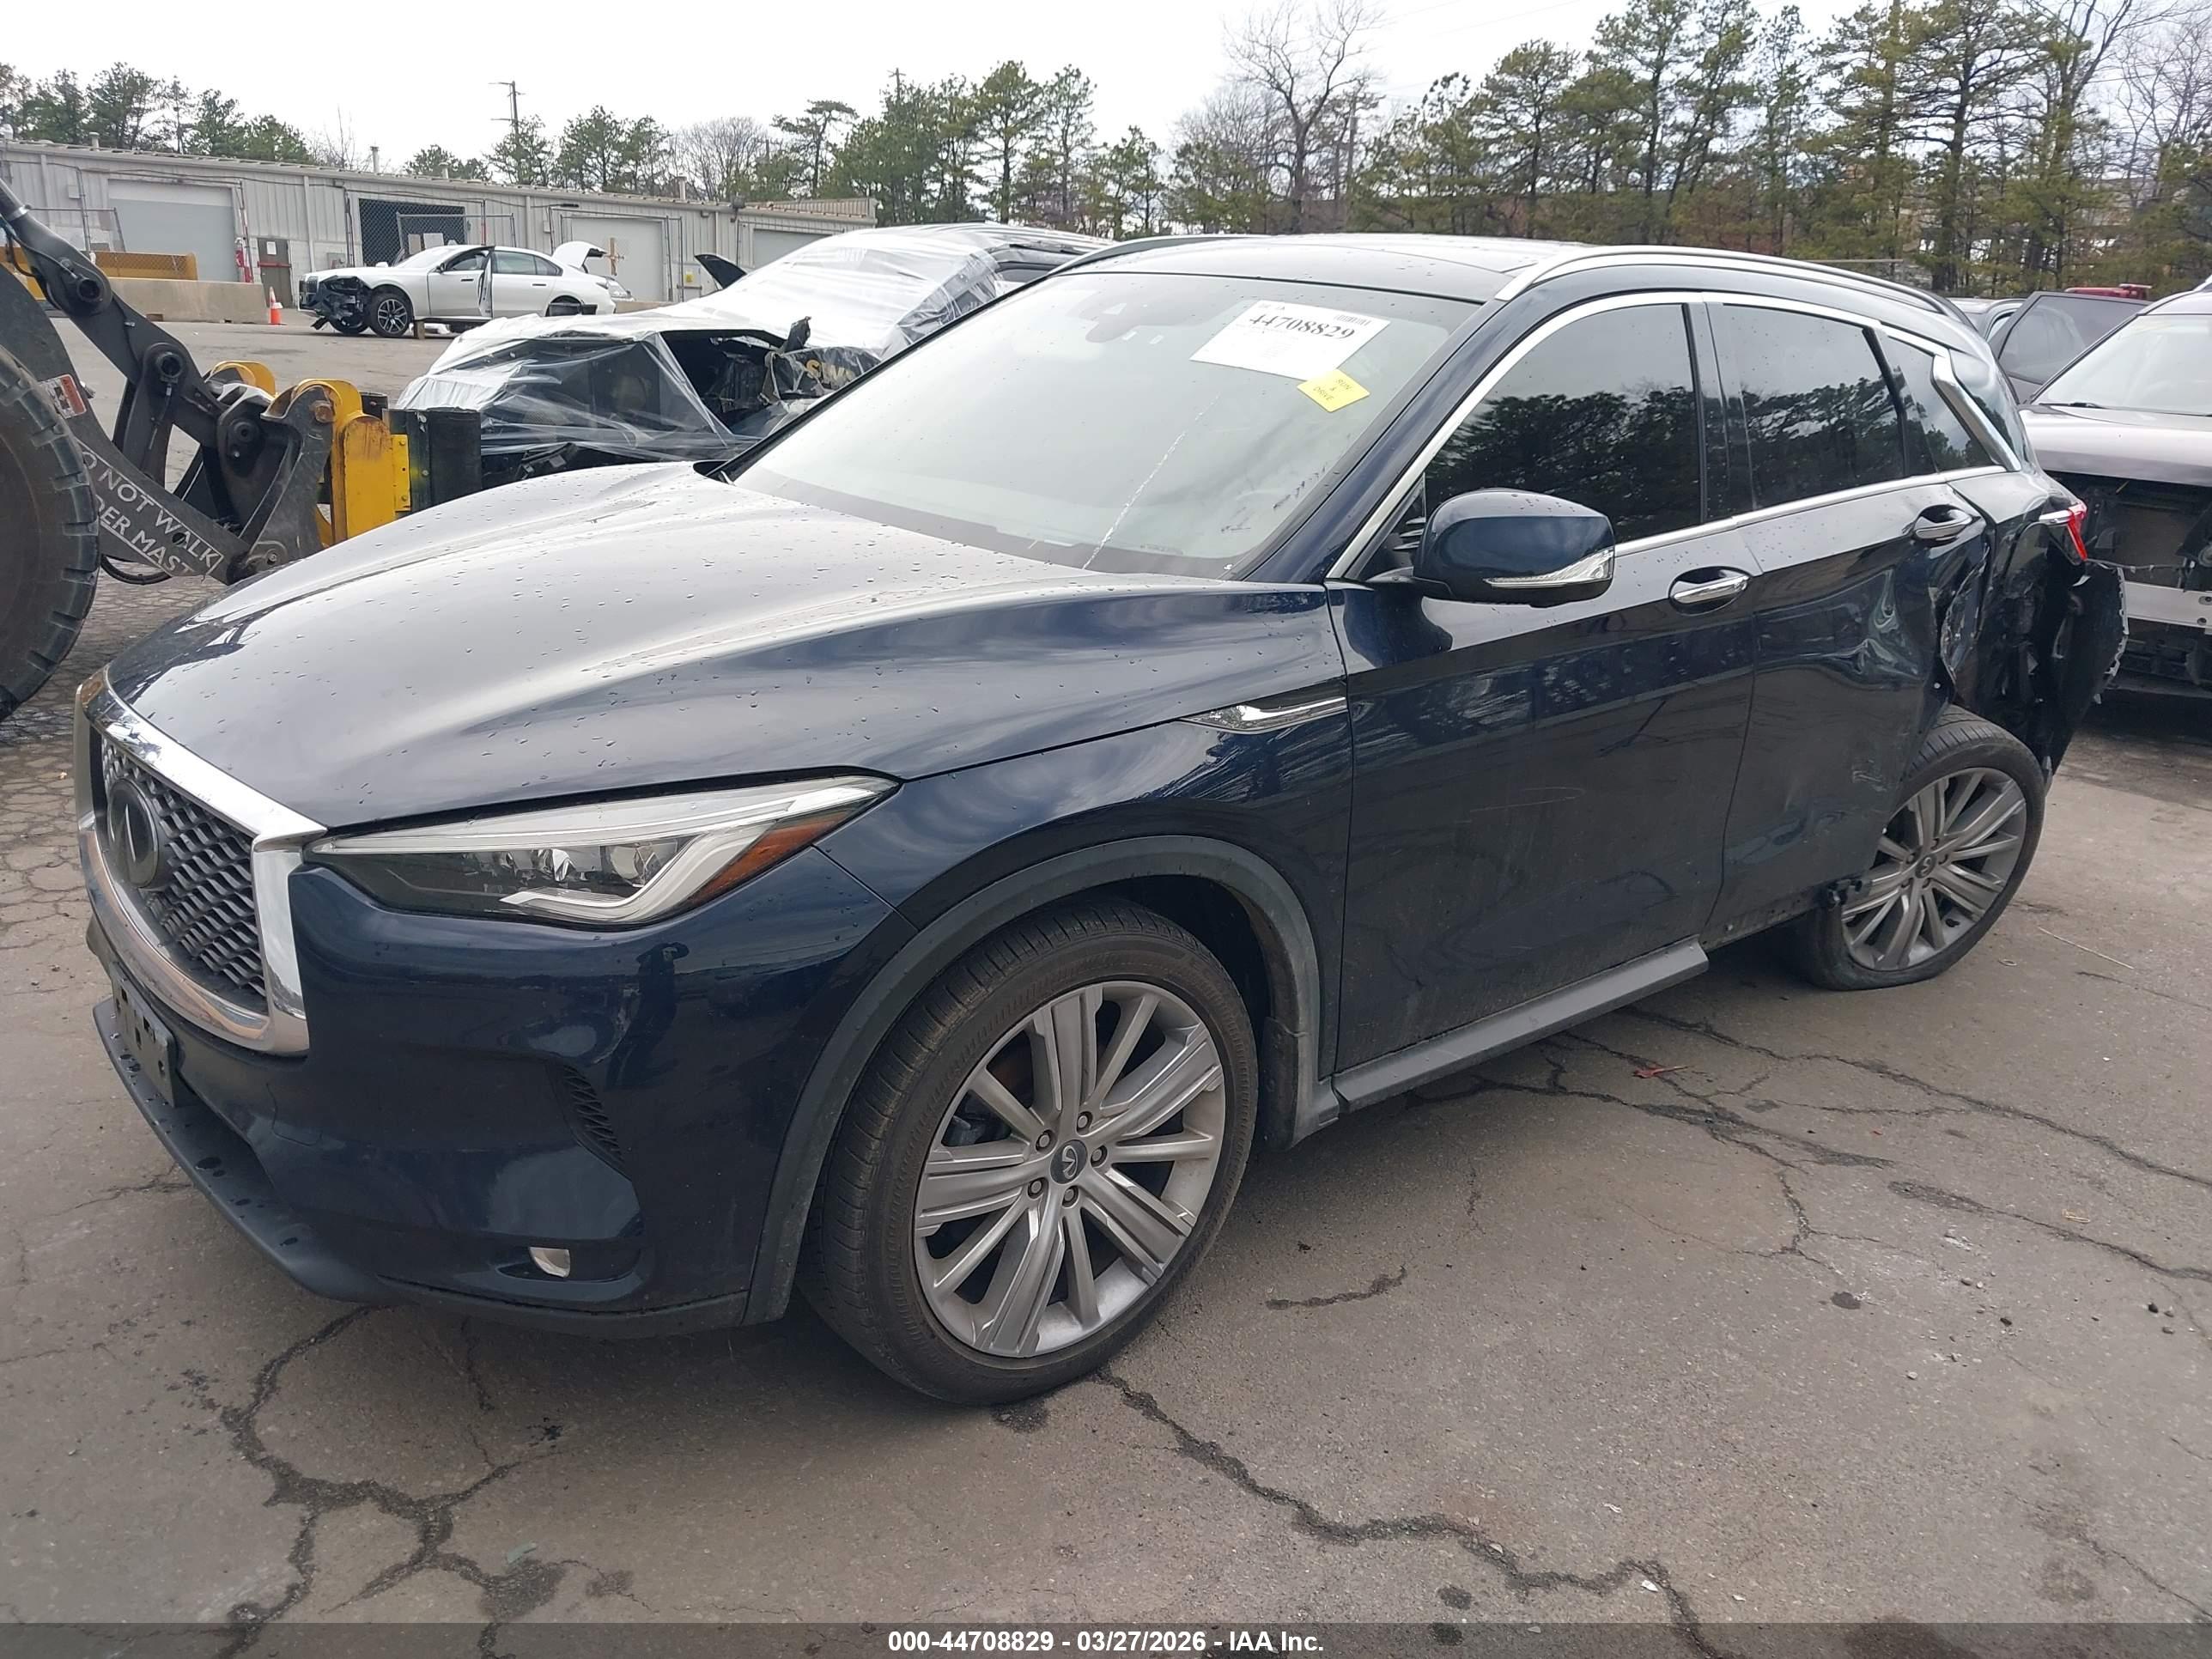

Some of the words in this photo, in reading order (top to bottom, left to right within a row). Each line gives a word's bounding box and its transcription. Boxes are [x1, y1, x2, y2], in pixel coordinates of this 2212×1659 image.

[1249, 313, 1355, 339] 44708829
[82, 451, 97, 470] O
[98, 467, 155, 513] NOT
[155, 508, 219, 568] WALK
[131, 530, 194, 574] MAST
